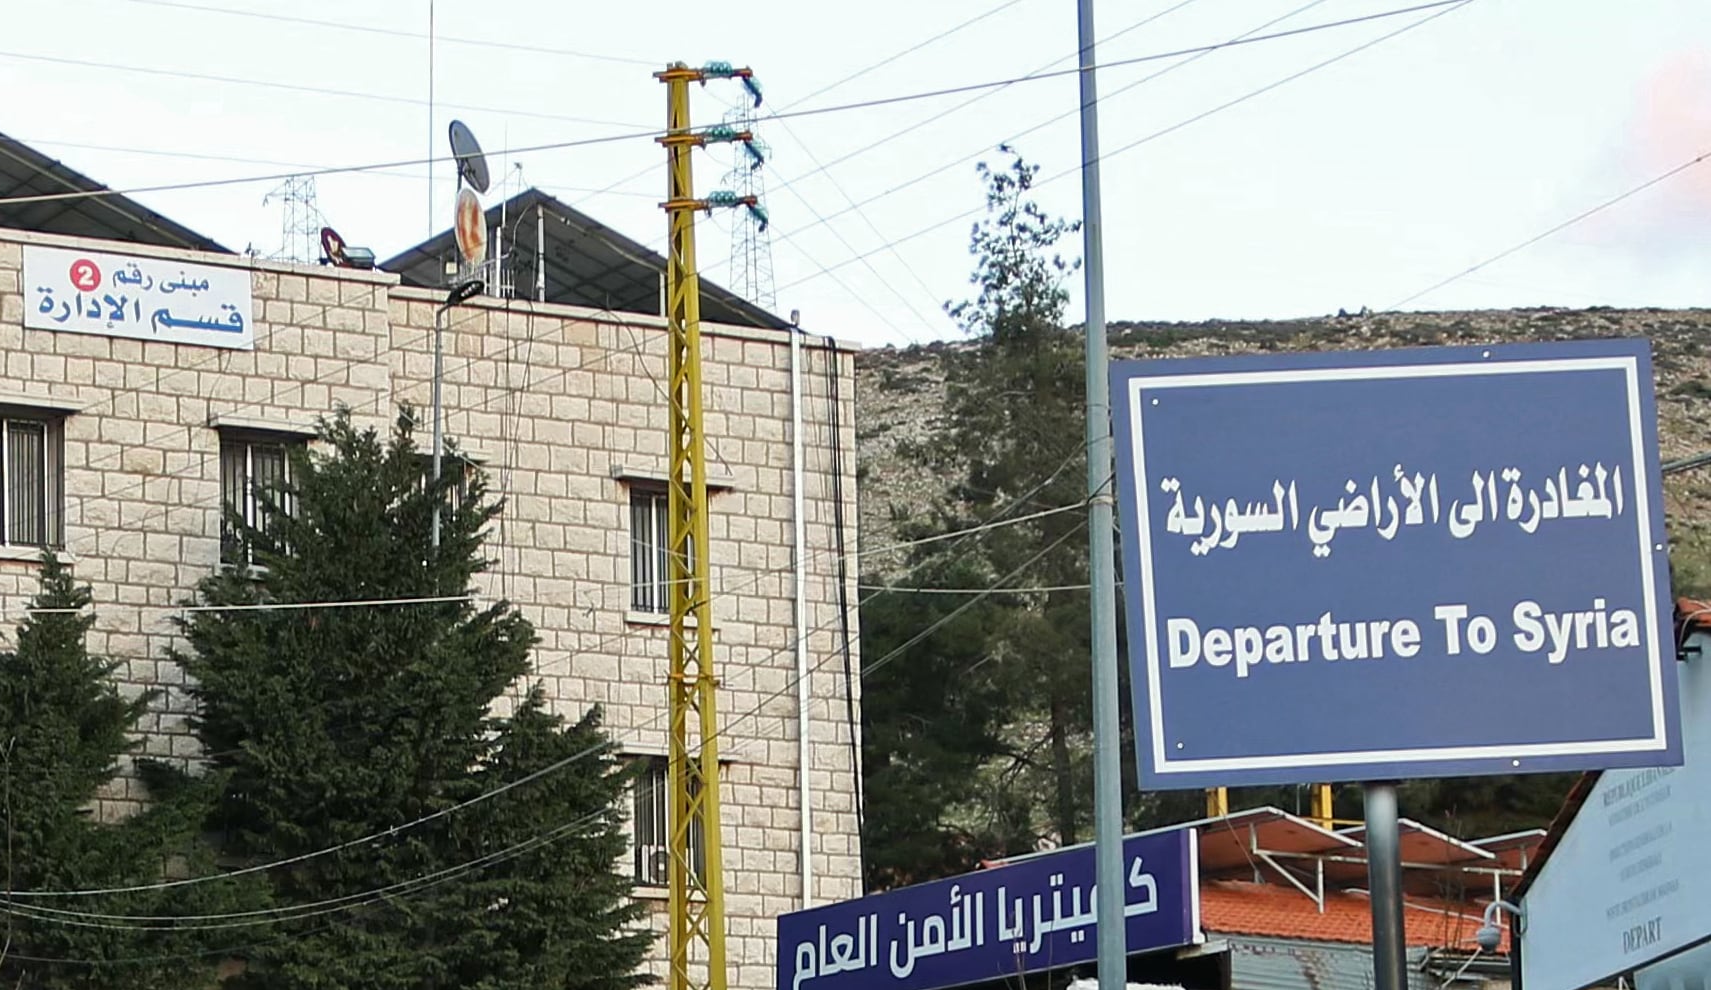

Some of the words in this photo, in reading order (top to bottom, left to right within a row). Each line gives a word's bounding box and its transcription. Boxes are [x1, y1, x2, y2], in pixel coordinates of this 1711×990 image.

[77, 265, 95, 286] 2
[112, 262, 153, 292] رقم
[160, 270, 210, 298] مبنى
[36, 286, 141, 329] الإدارة
[151, 303, 244, 334] قسم
[1160, 476, 1300, 557] السورية
[1308, 463, 1440, 558] الأراضي
[1448, 469, 1498, 539] الى
[1501, 461, 1626, 535] المغادرة
[1166, 611, 1422, 678] Departure
[1434, 604, 1497, 656] To
[1513, 598, 1641, 664] Syria
[889, 884, 985, 979] الأمن
[1623, 917, 1662, 954] DEPART
